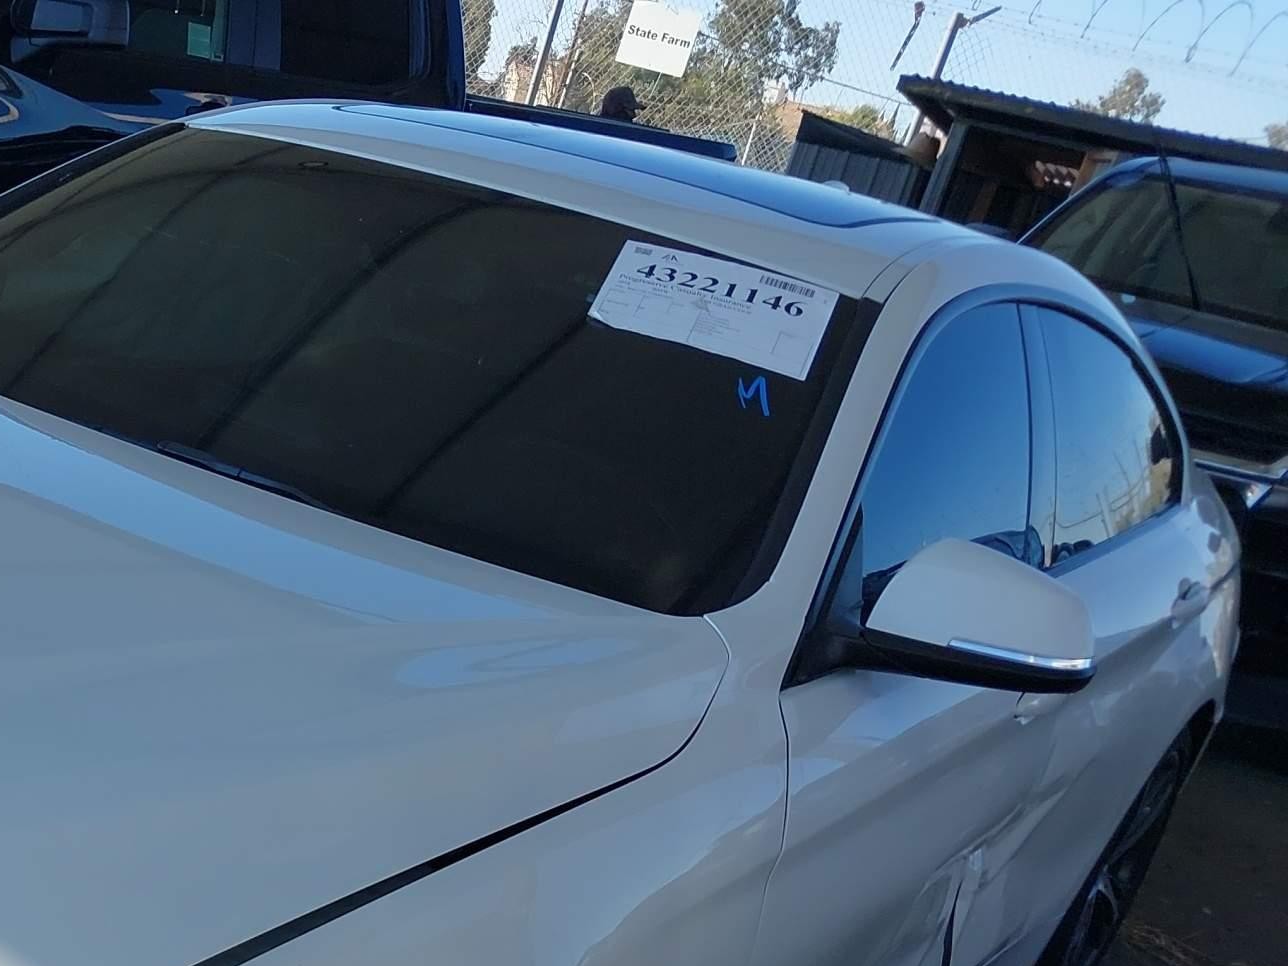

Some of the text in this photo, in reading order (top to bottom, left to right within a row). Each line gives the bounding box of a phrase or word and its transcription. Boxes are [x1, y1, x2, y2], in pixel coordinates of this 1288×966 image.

[628, 24, 691, 49] State Farm
[636, 263, 807, 318] 43221146
